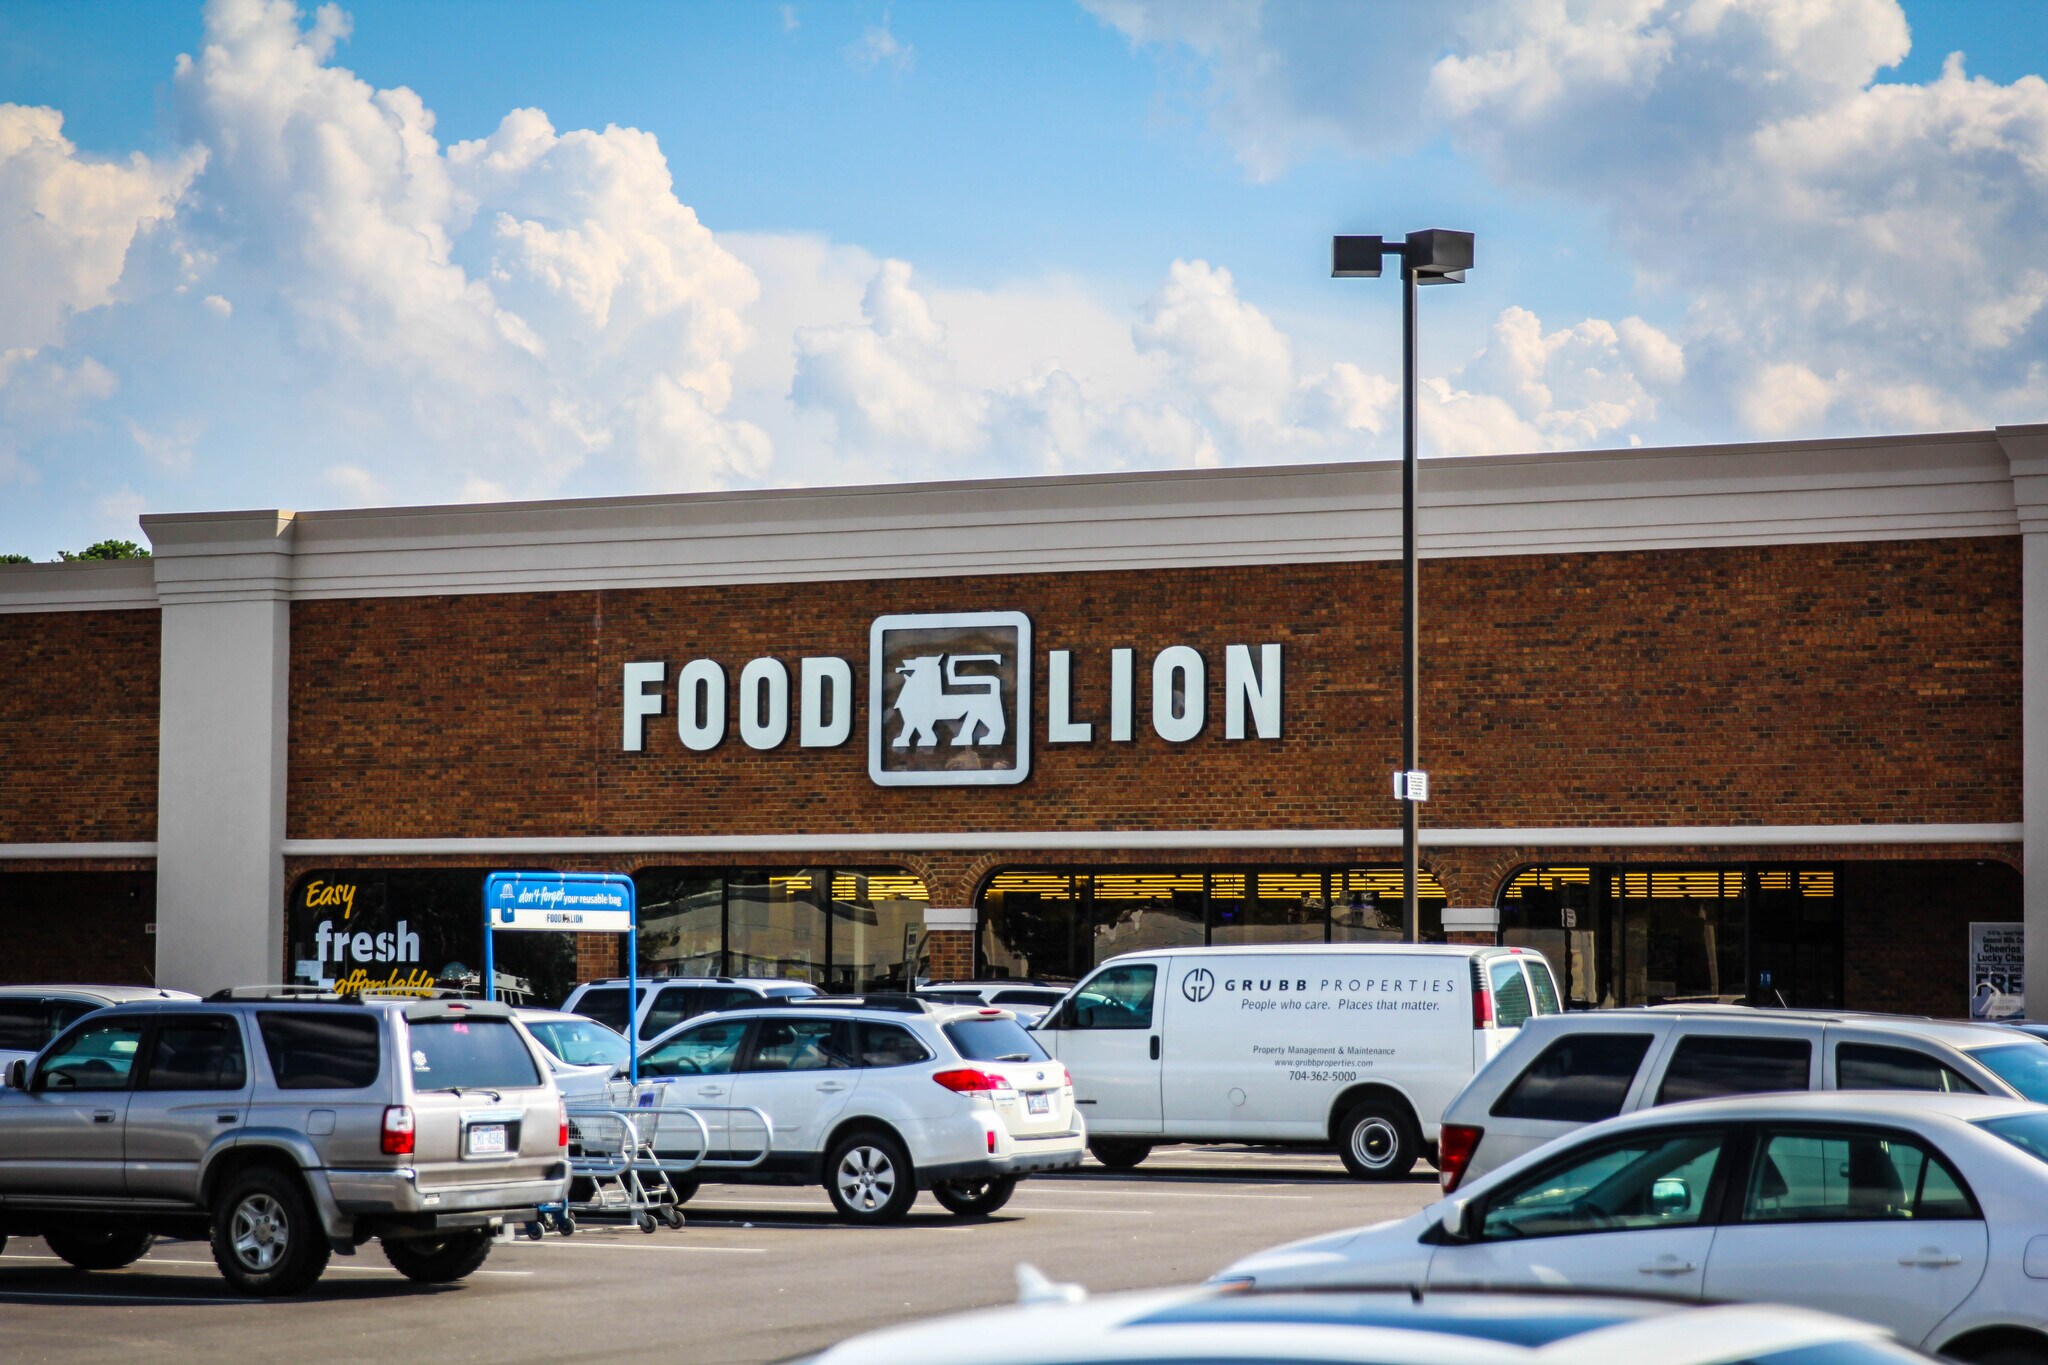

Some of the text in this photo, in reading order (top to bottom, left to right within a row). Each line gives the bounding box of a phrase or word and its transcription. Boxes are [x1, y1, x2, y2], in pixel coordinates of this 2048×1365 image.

[622, 643, 1282, 751] FOOD LION
[306, 880, 356, 919] Easy
[540, 886, 566, 909] forget
[563, 895, 579, 905] your
[580, 893, 607, 905] reusable
[608, 894, 622, 907] bag
[546, 913, 584, 924] FOOD LION
[315, 920, 420, 962] fresh
[1983, 944, 2021, 953] Cheerios
[1977, 953, 2003, 964] Lucky
[1224, 979, 1454, 992] GRUBB PROPERTIES
[1241, 999, 1440, 1011] People who care. Places that matter.
[1253, 1045, 1396, 1056] Property Management & Maintenance
[1274, 1058, 1373, 1068] www.grubbproperties.com
[1289, 1071, 1357, 1081] 704-362-5000
